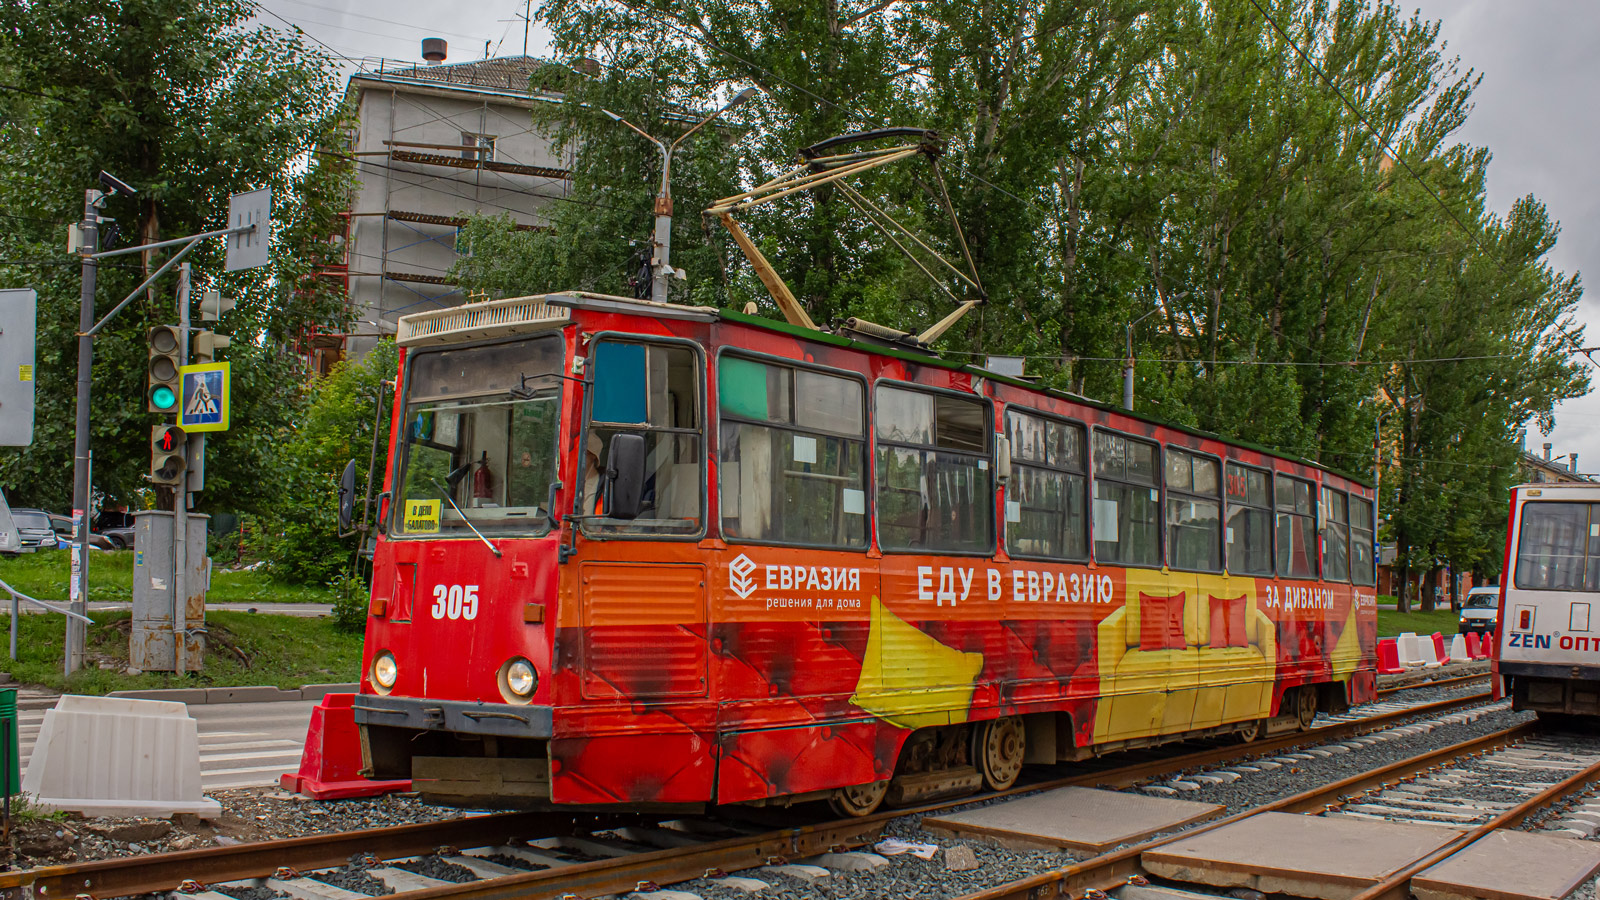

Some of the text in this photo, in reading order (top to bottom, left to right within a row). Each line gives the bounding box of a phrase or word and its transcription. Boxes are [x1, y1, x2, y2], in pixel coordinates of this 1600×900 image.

[1227, 473, 1246, 498] 305
[412, 505, 432, 517] В ДЕПО
[765, 564, 860, 591] ЕВРАЗИЯ
[917, 565, 1114, 607] ЕДУ В ЕВРАЗИЮ
[431, 584, 479, 620] 305
[766, 597, 861, 611] решения для дома
[1265, 585, 1334, 612] ЗА ДИВАНОМ
